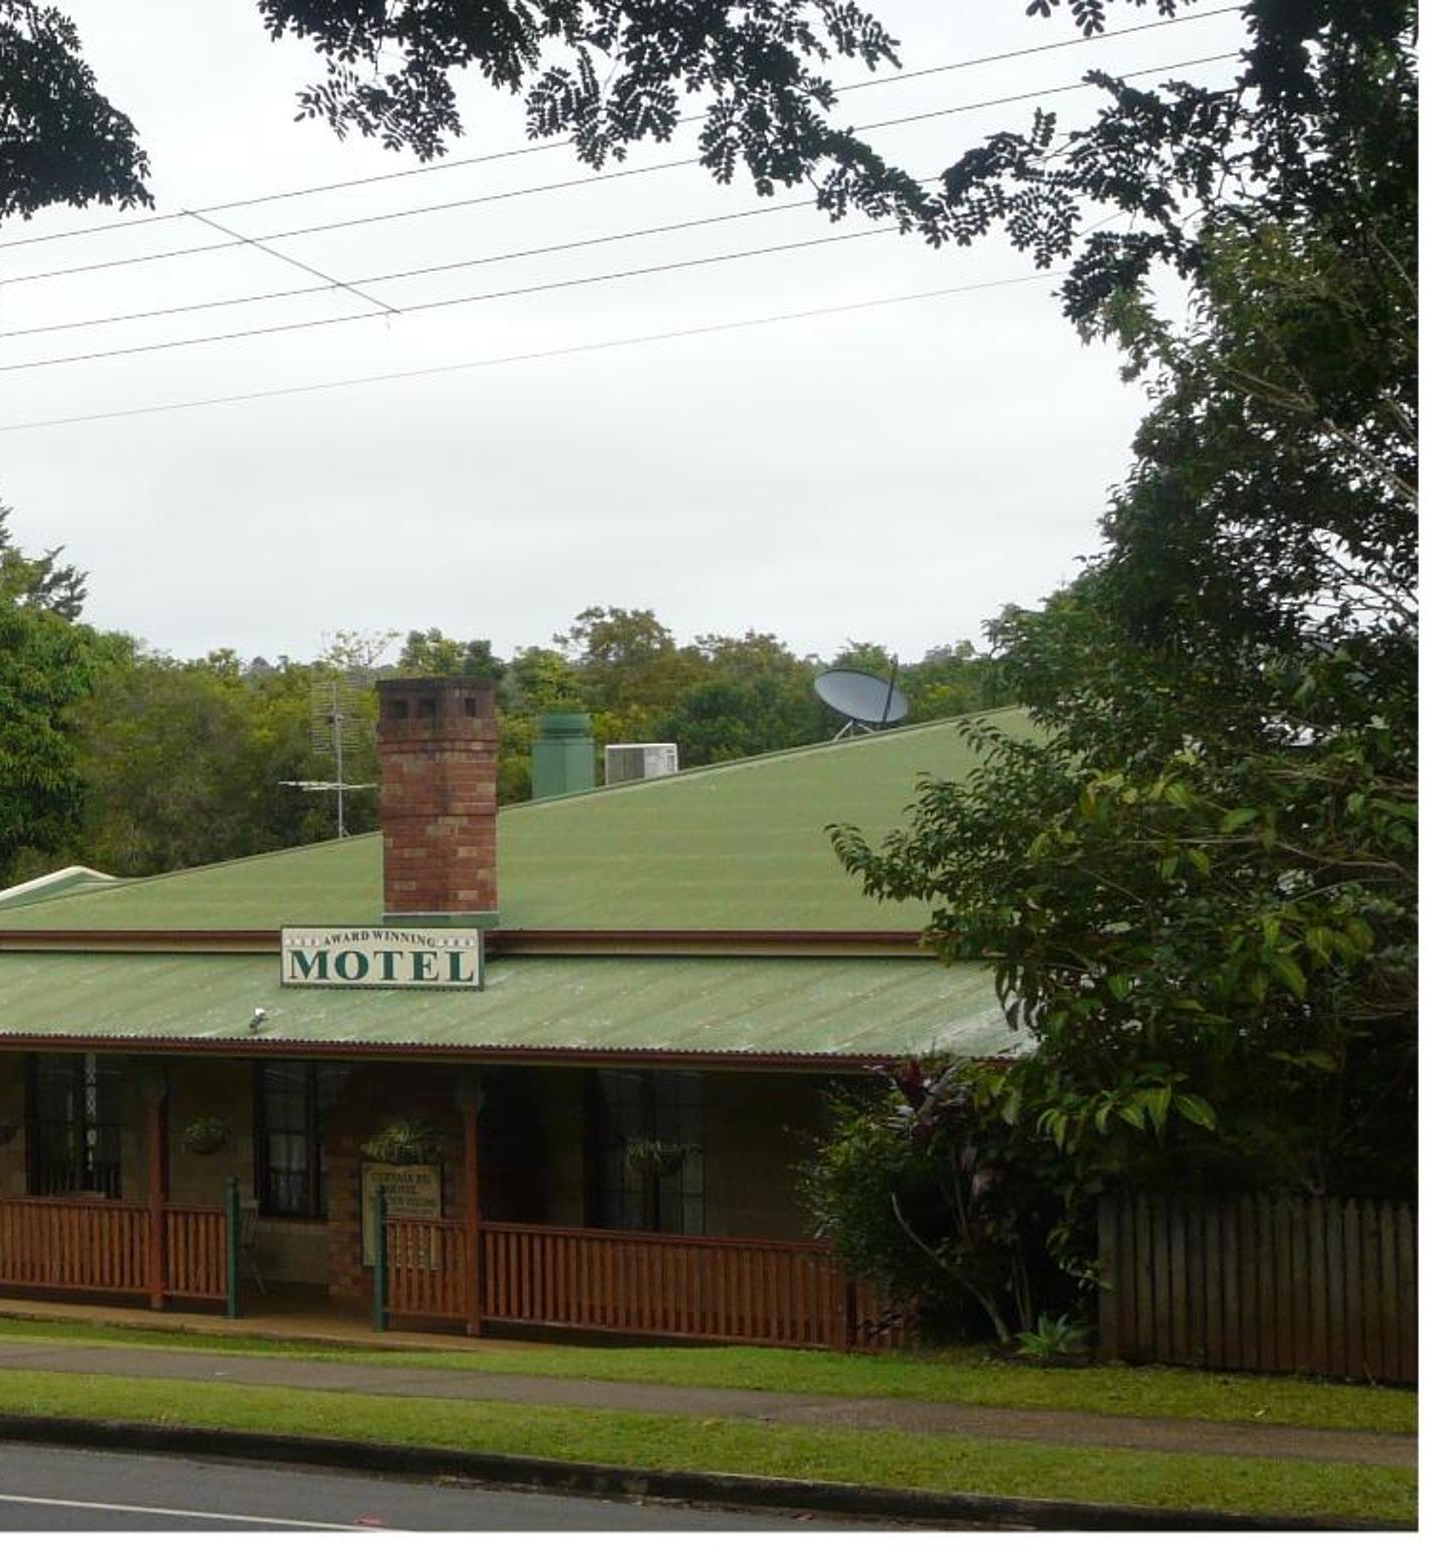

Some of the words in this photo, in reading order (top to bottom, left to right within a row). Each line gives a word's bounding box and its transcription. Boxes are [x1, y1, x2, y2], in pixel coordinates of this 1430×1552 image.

[324, 930, 369, 946] AWARD
[372, 930, 436, 948] WINNING
[289, 950, 474, 982] MOTEL
